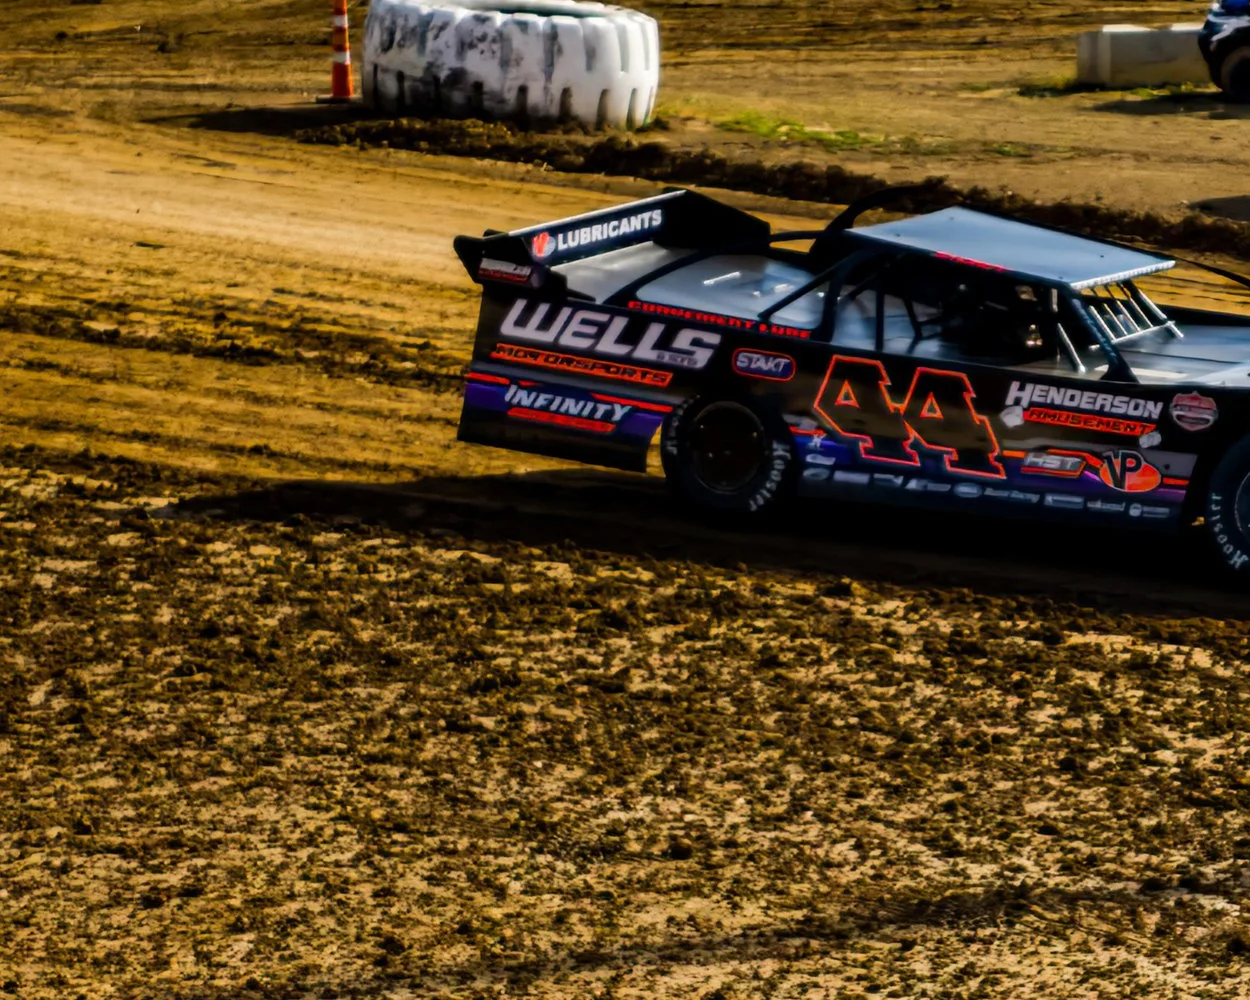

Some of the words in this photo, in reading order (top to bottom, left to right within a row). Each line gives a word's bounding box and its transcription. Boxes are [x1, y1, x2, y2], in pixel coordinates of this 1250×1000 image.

[557, 209, 662, 250] LUBRICANTS
[500, 299, 722, 369] WELLS
[493, 344, 671, 386] MOTORSPORTS
[503, 383, 634, 422] INFINITY
[1004, 380, 1164, 420] HENDERSON
[1027, 408, 1152, 436] AMUSEMENT
[1101, 449, 1144, 491] VP
